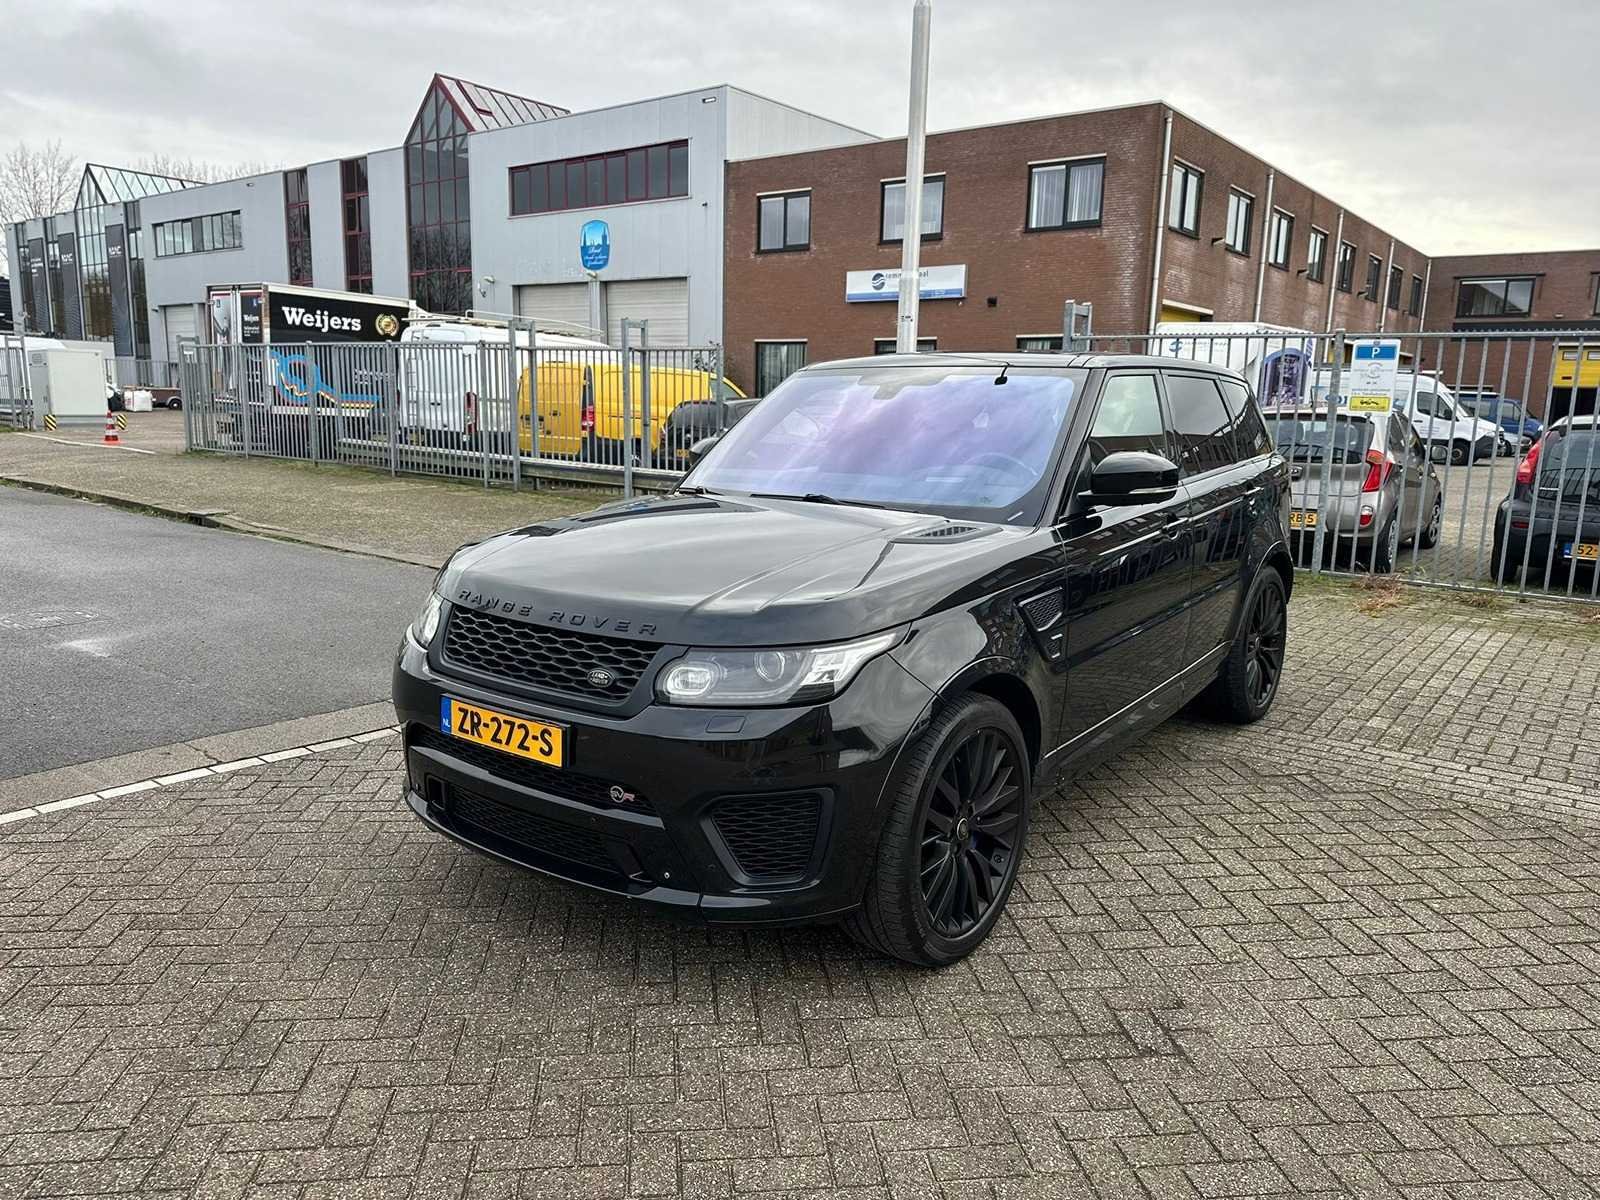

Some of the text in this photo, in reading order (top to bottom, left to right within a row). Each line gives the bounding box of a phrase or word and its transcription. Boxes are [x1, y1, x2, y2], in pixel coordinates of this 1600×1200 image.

[281, 305, 361, 333] Weijers
[1371, 347, 1381, 359] P
[458, 589, 658, 636] RANGE ROVER
[442, 718, 451, 728] NL
[457, 707, 554, 757] ZR-272-S
